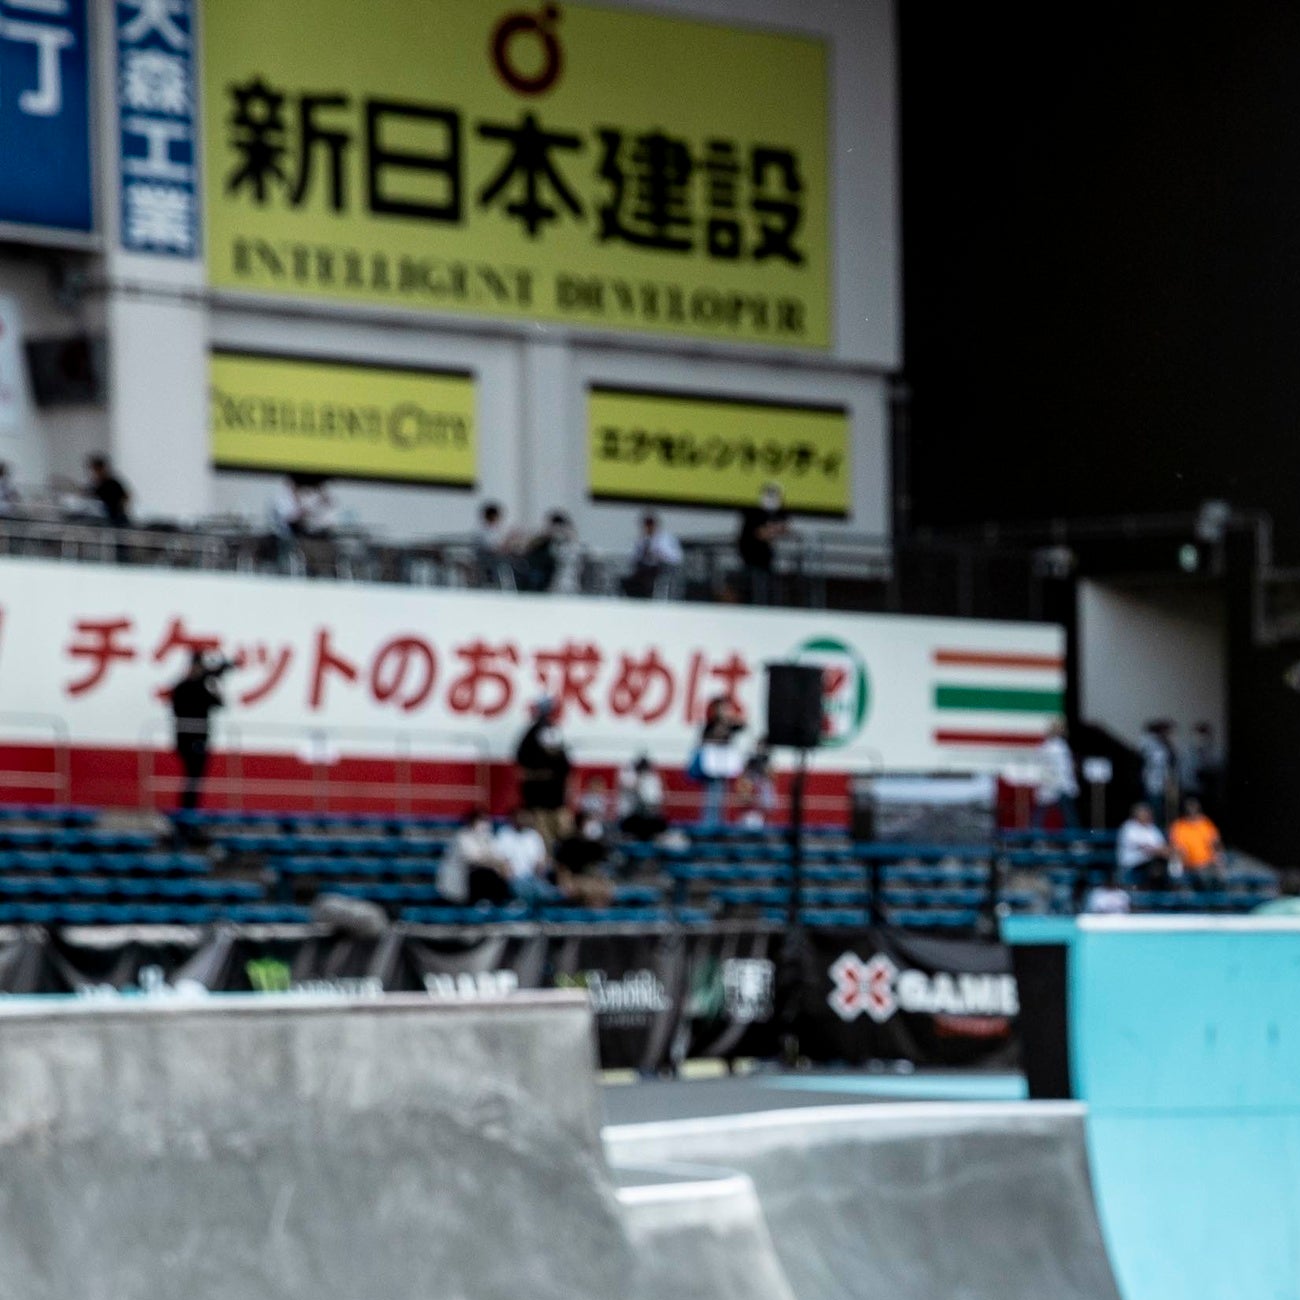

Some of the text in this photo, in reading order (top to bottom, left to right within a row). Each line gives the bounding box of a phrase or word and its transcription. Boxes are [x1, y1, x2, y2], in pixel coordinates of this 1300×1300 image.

[225, 76, 807, 268] 新日本建設
[231, 236, 808, 334] INTELLIGENT DEVELOPER
[899, 969, 1020, 1016] GAME
